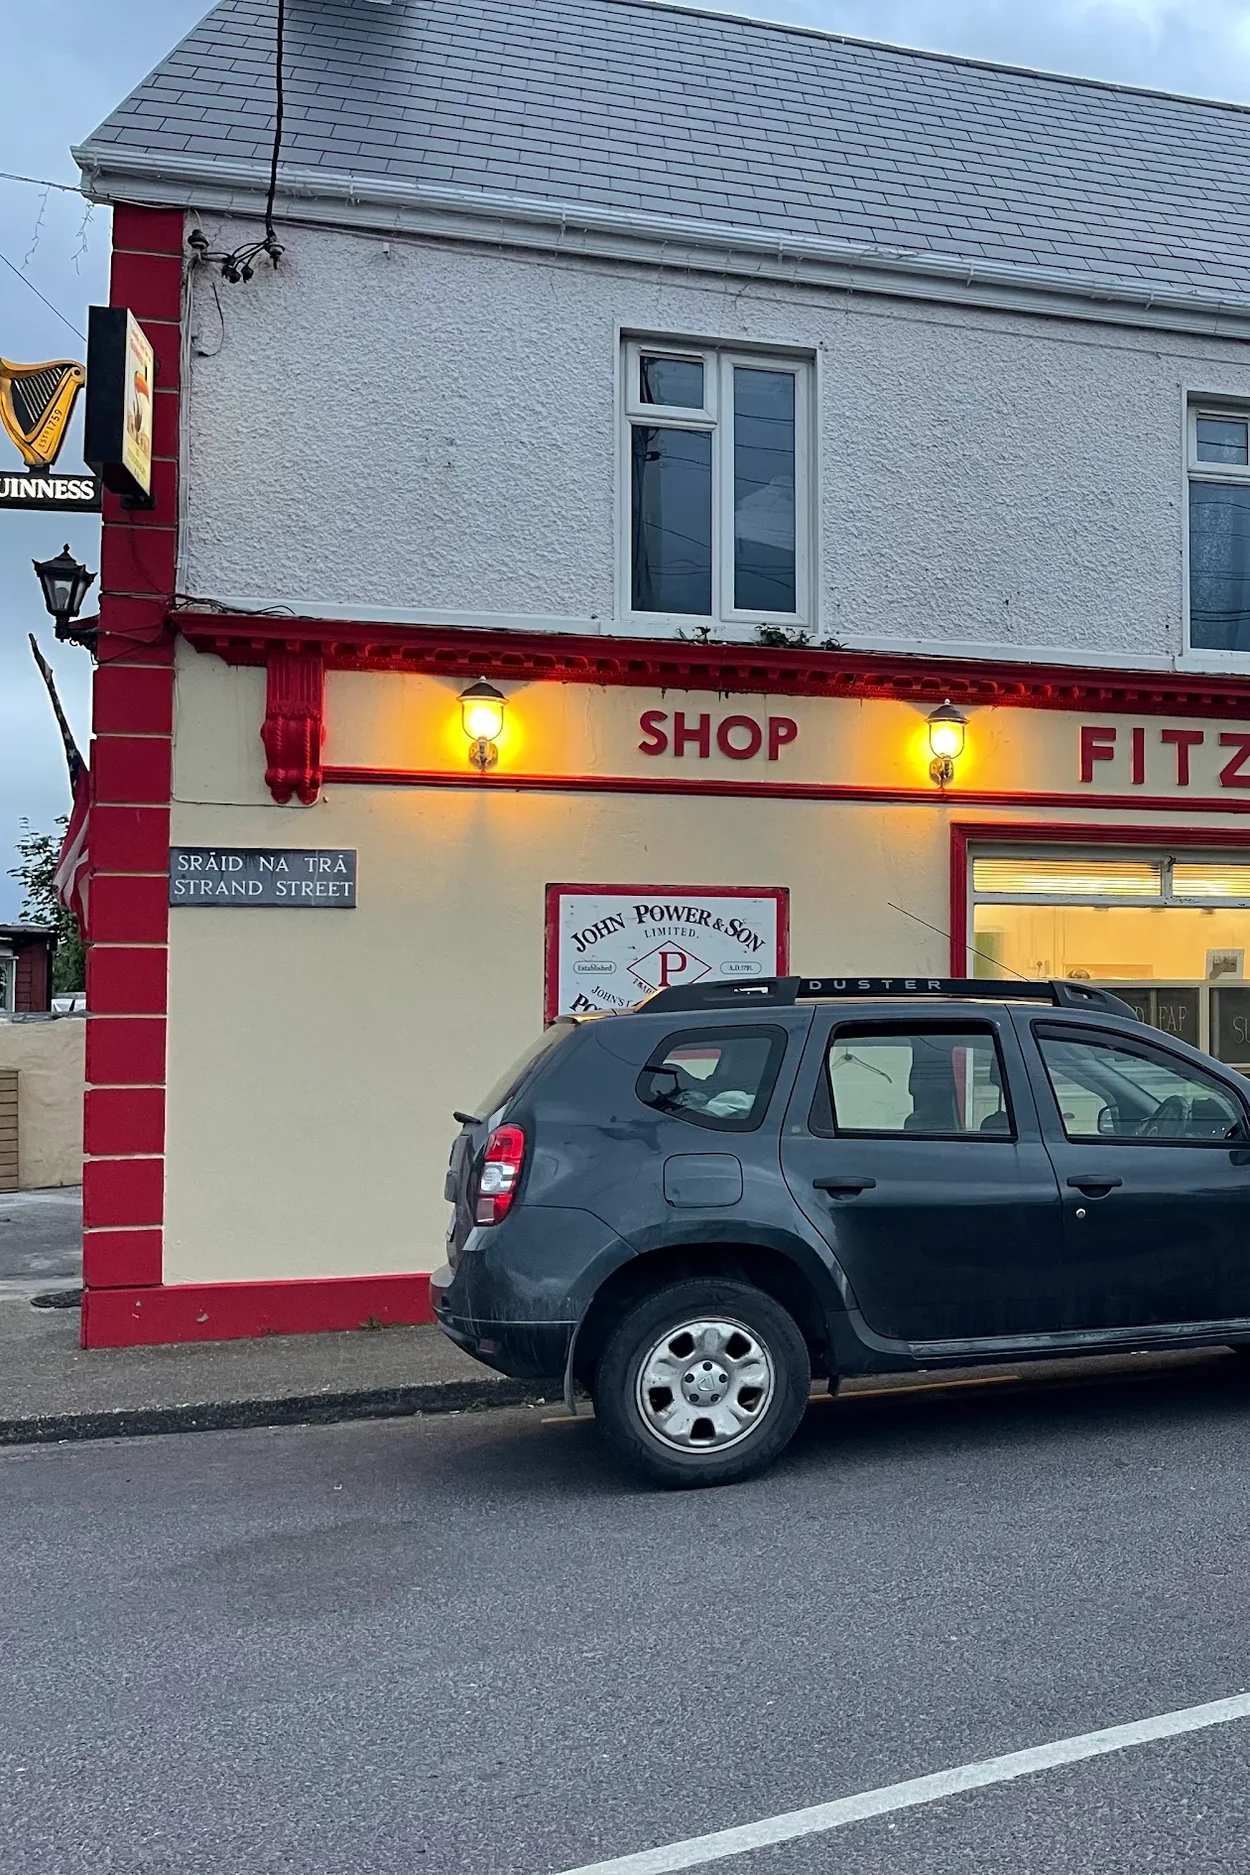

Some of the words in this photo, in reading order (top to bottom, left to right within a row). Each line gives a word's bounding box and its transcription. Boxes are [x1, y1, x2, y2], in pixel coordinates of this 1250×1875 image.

[637, 709, 799, 761] SHOP
[177, 851, 244, 872] SRÁID
[259, 857, 290, 873] NA
[304, 854, 348, 874] TRÁ
[174, 879, 264, 896] STRAND
[275, 880, 354, 898] STREET
[570, 912, 627, 954] JOHN
[658, 951, 688, 987] P
[591, 985, 625, 1007] JOHN'S
[809, 980, 941, 990] DUSTER
